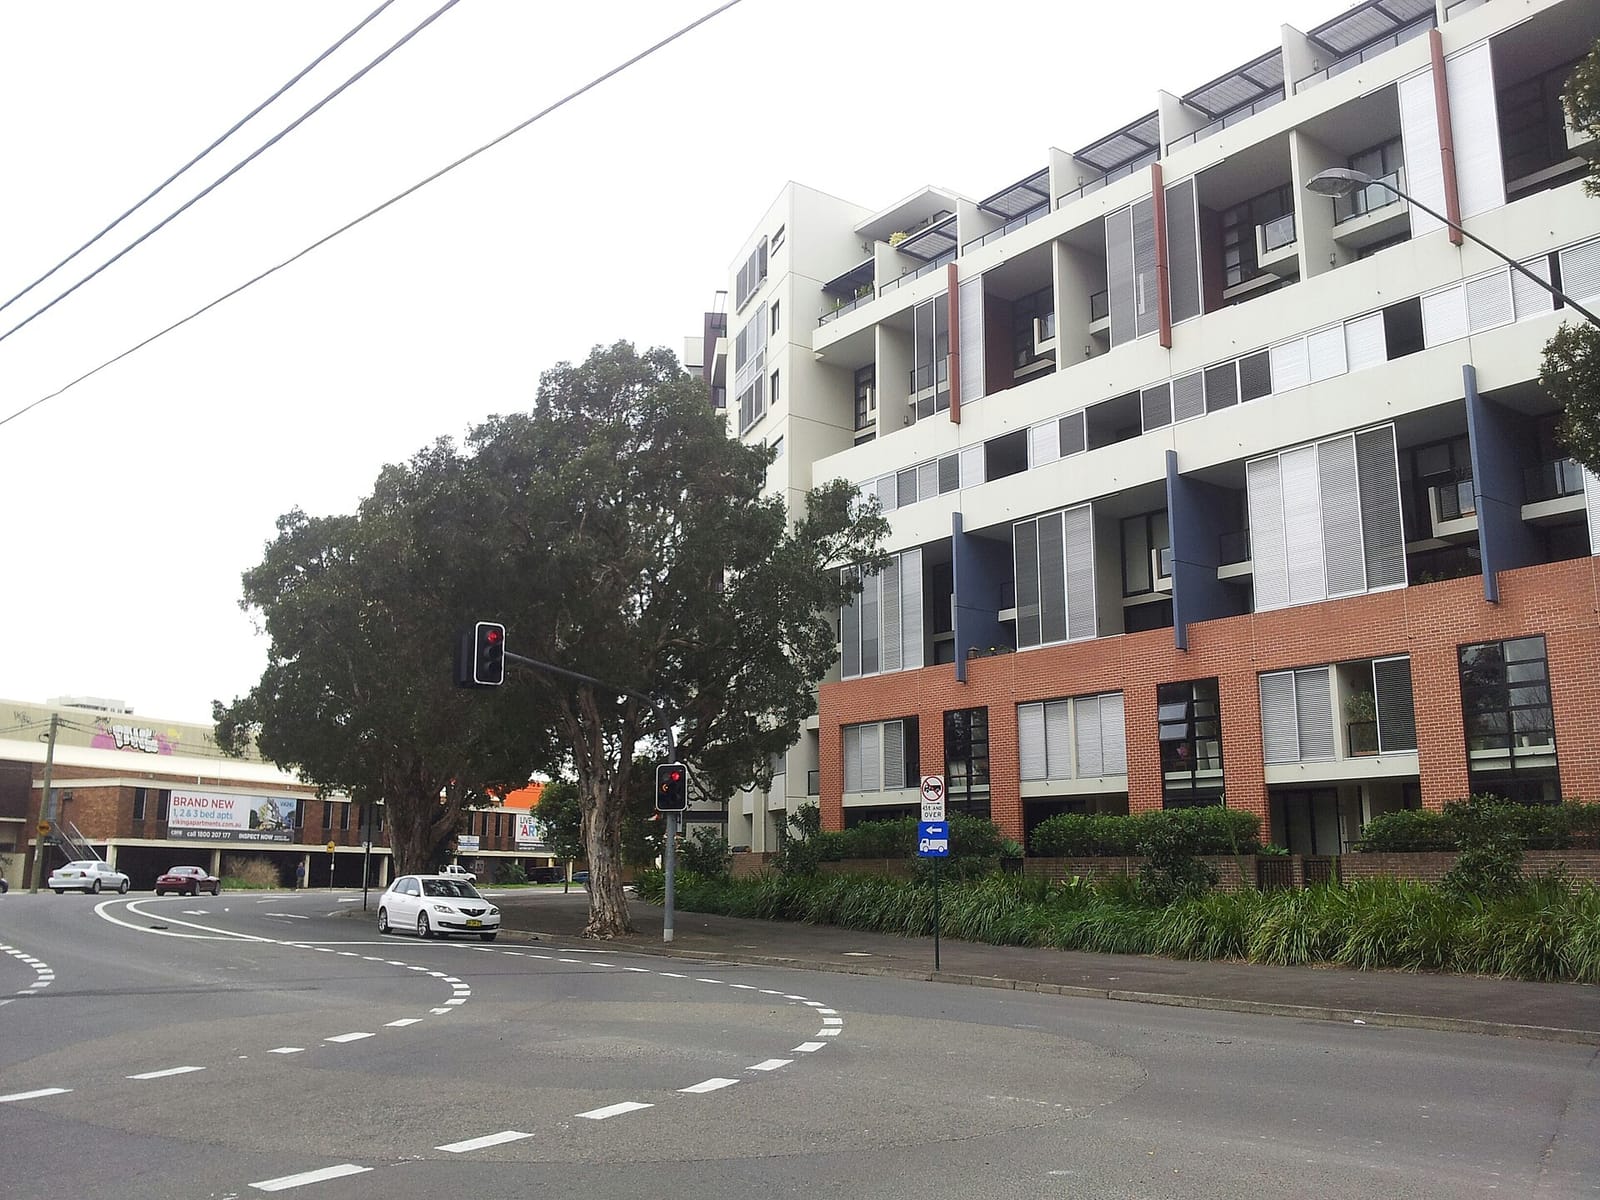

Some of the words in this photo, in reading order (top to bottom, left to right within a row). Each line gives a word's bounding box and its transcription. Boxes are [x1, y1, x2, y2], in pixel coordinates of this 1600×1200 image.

[173, 796, 209, 808] BRAND
[211, 799, 234, 809] NEW
[192, 810, 199, 818] 3
[199, 810, 215, 819] bed
[216, 812, 233, 820] apts
